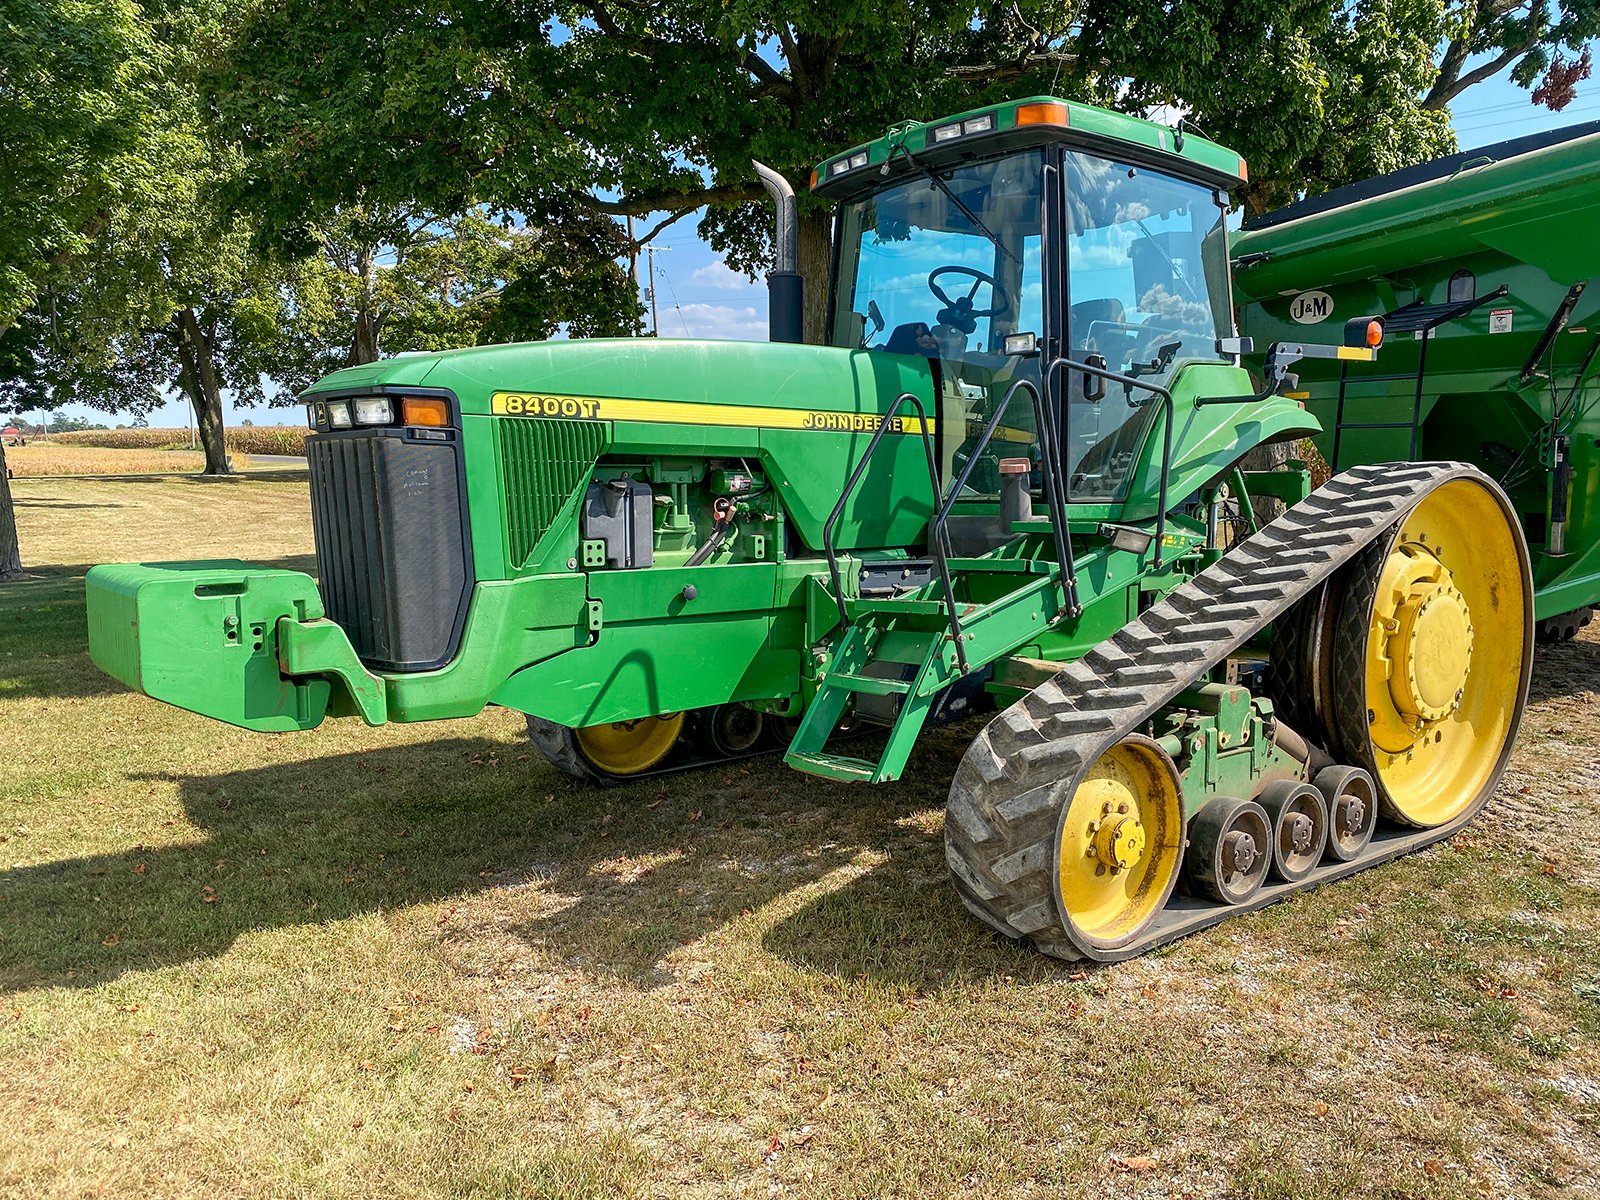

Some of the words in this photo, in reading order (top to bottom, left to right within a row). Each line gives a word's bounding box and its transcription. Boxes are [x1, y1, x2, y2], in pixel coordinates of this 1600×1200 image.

[1292, 296, 1328, 319] J&M
[506, 396, 600, 420] 8400T
[803, 413, 850, 431] JOHN
